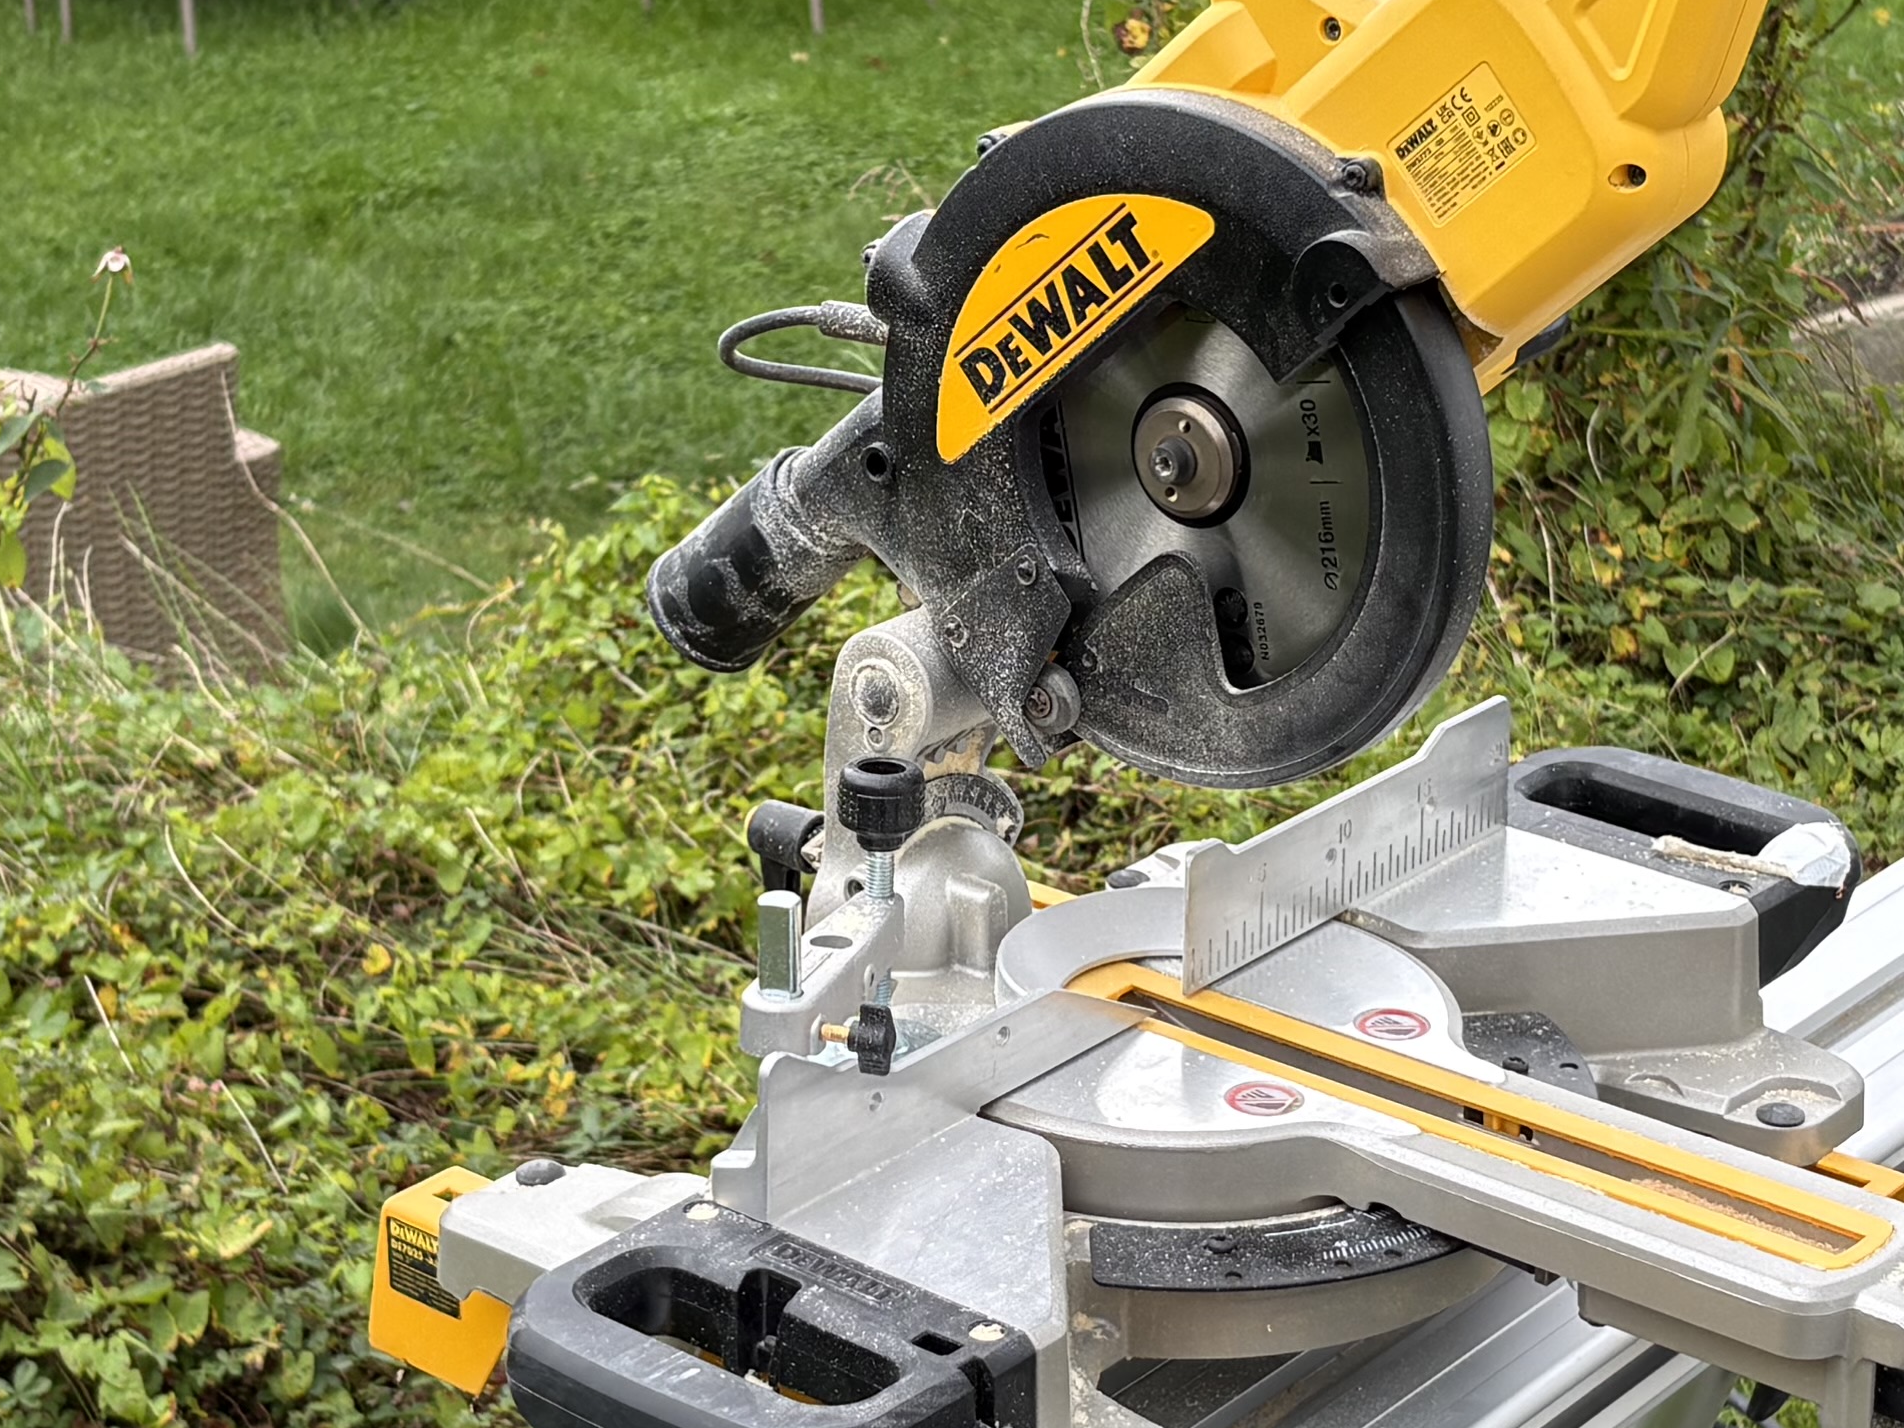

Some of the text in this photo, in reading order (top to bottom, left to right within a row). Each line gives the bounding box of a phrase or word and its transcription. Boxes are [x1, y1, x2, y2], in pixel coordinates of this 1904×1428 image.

[959, 212, 1151, 406] DEWALT
[1300, 399, 1320, 436] x30
[1339, 819, 1352, 844] 10
[771, 1242, 894, 1302] DEWALT
